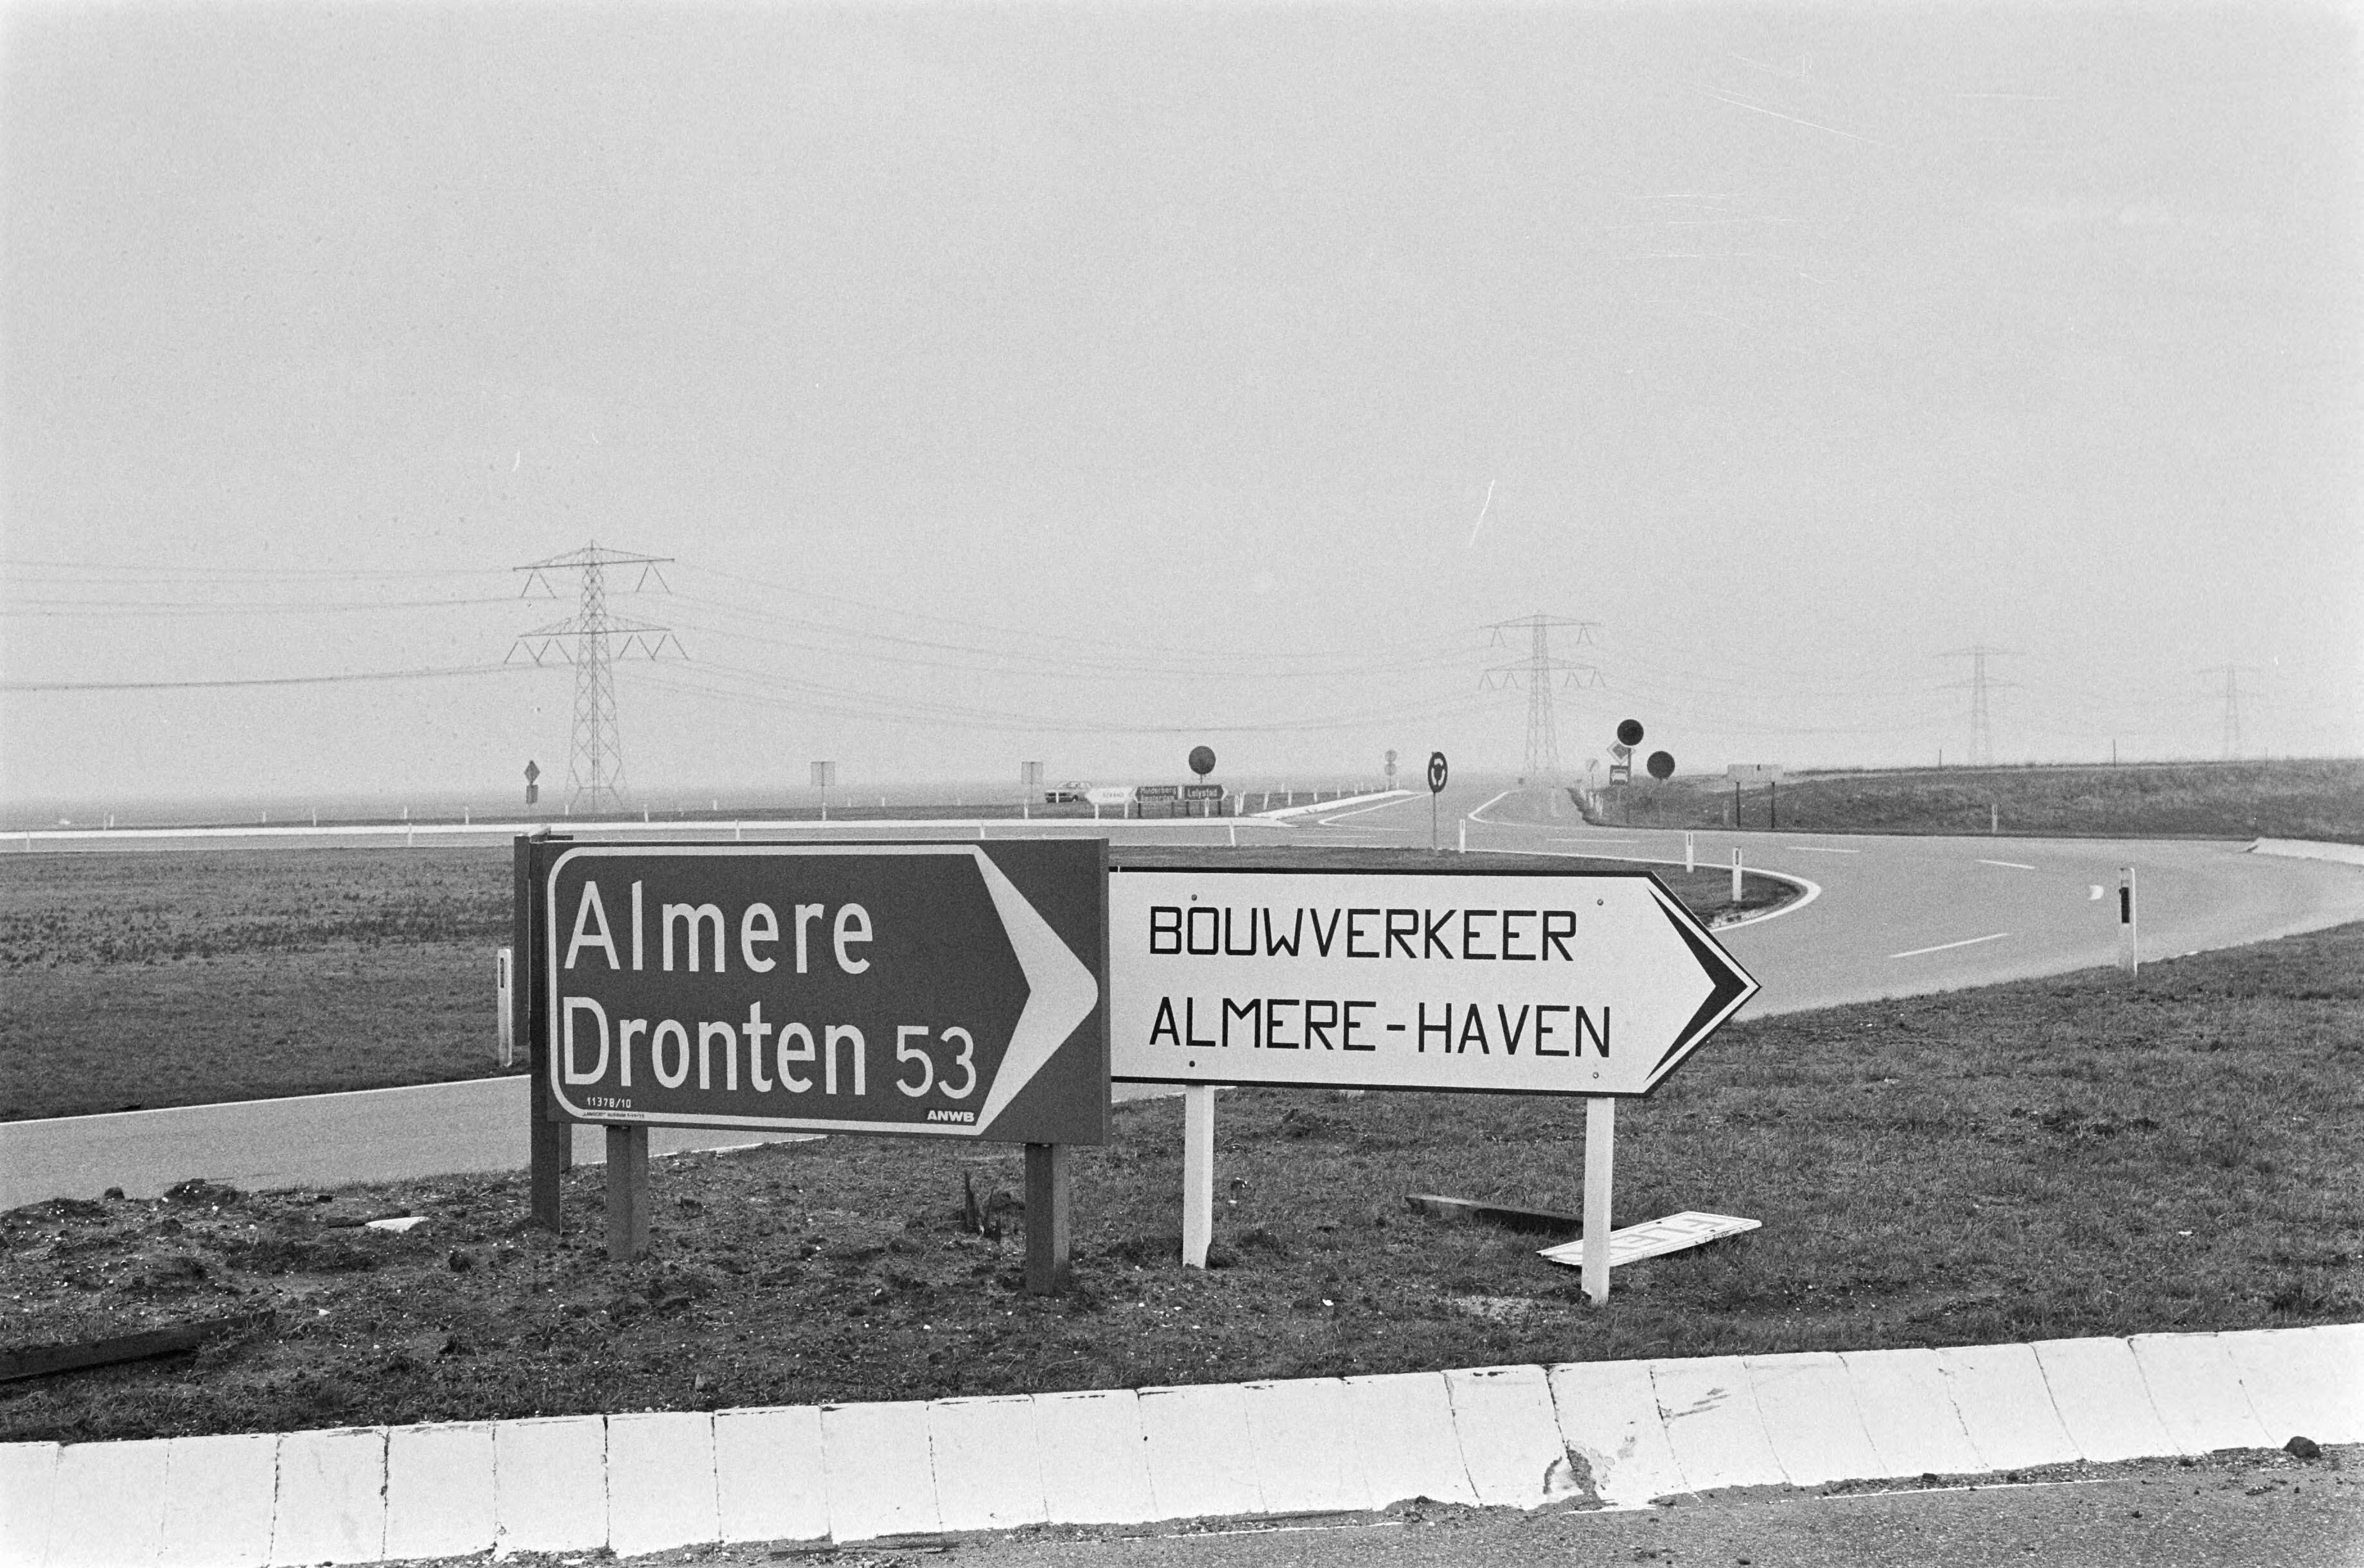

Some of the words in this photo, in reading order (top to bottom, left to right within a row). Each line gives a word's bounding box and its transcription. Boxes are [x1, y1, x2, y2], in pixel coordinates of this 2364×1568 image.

[1188, 788, 1218, 799] Lelystad
[565, 880, 873, 974] Almere
[1150, 906, 1577, 962] BOUWVERKEER
[563, 997, 866, 1095] Dronten
[896, 1025, 976, 1099] 53
[587, 1097, 631, 1109] 11378/10
[927, 1110, 975, 1122] ANWB
